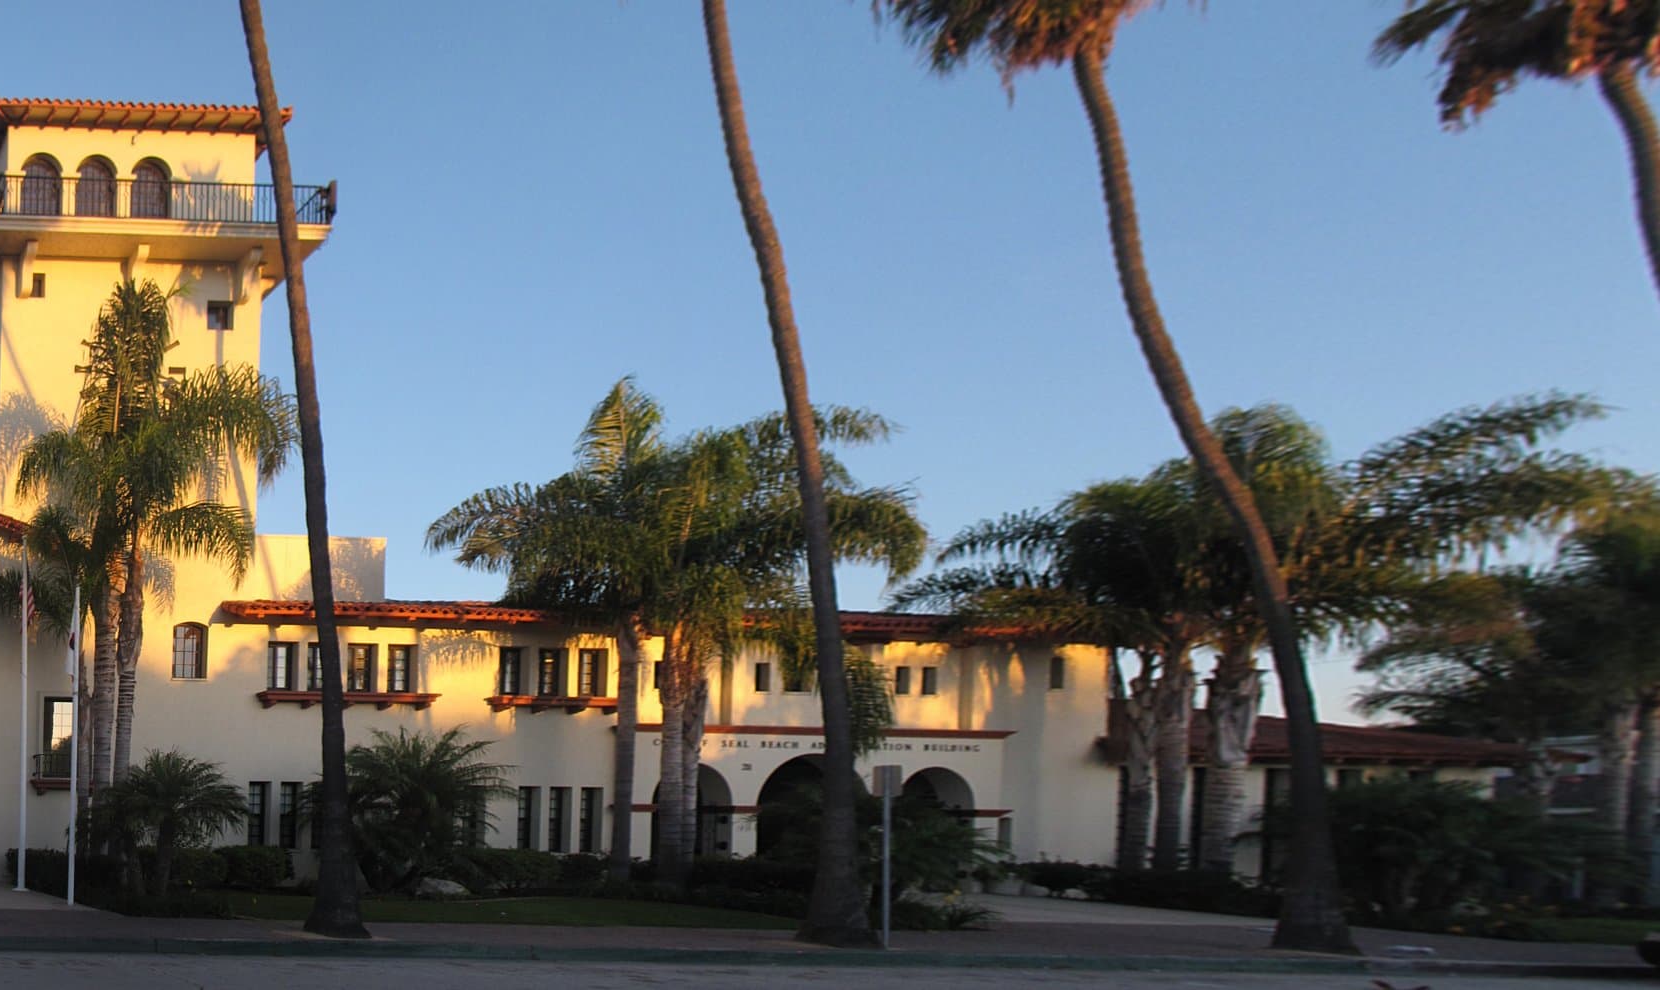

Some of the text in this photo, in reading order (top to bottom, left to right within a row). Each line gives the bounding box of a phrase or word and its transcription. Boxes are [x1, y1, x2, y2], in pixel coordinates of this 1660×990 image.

[721, 740, 749, 748] SEAL
[760, 740, 799, 749] BEACH
[923, 743, 981, 752] BUILDING
